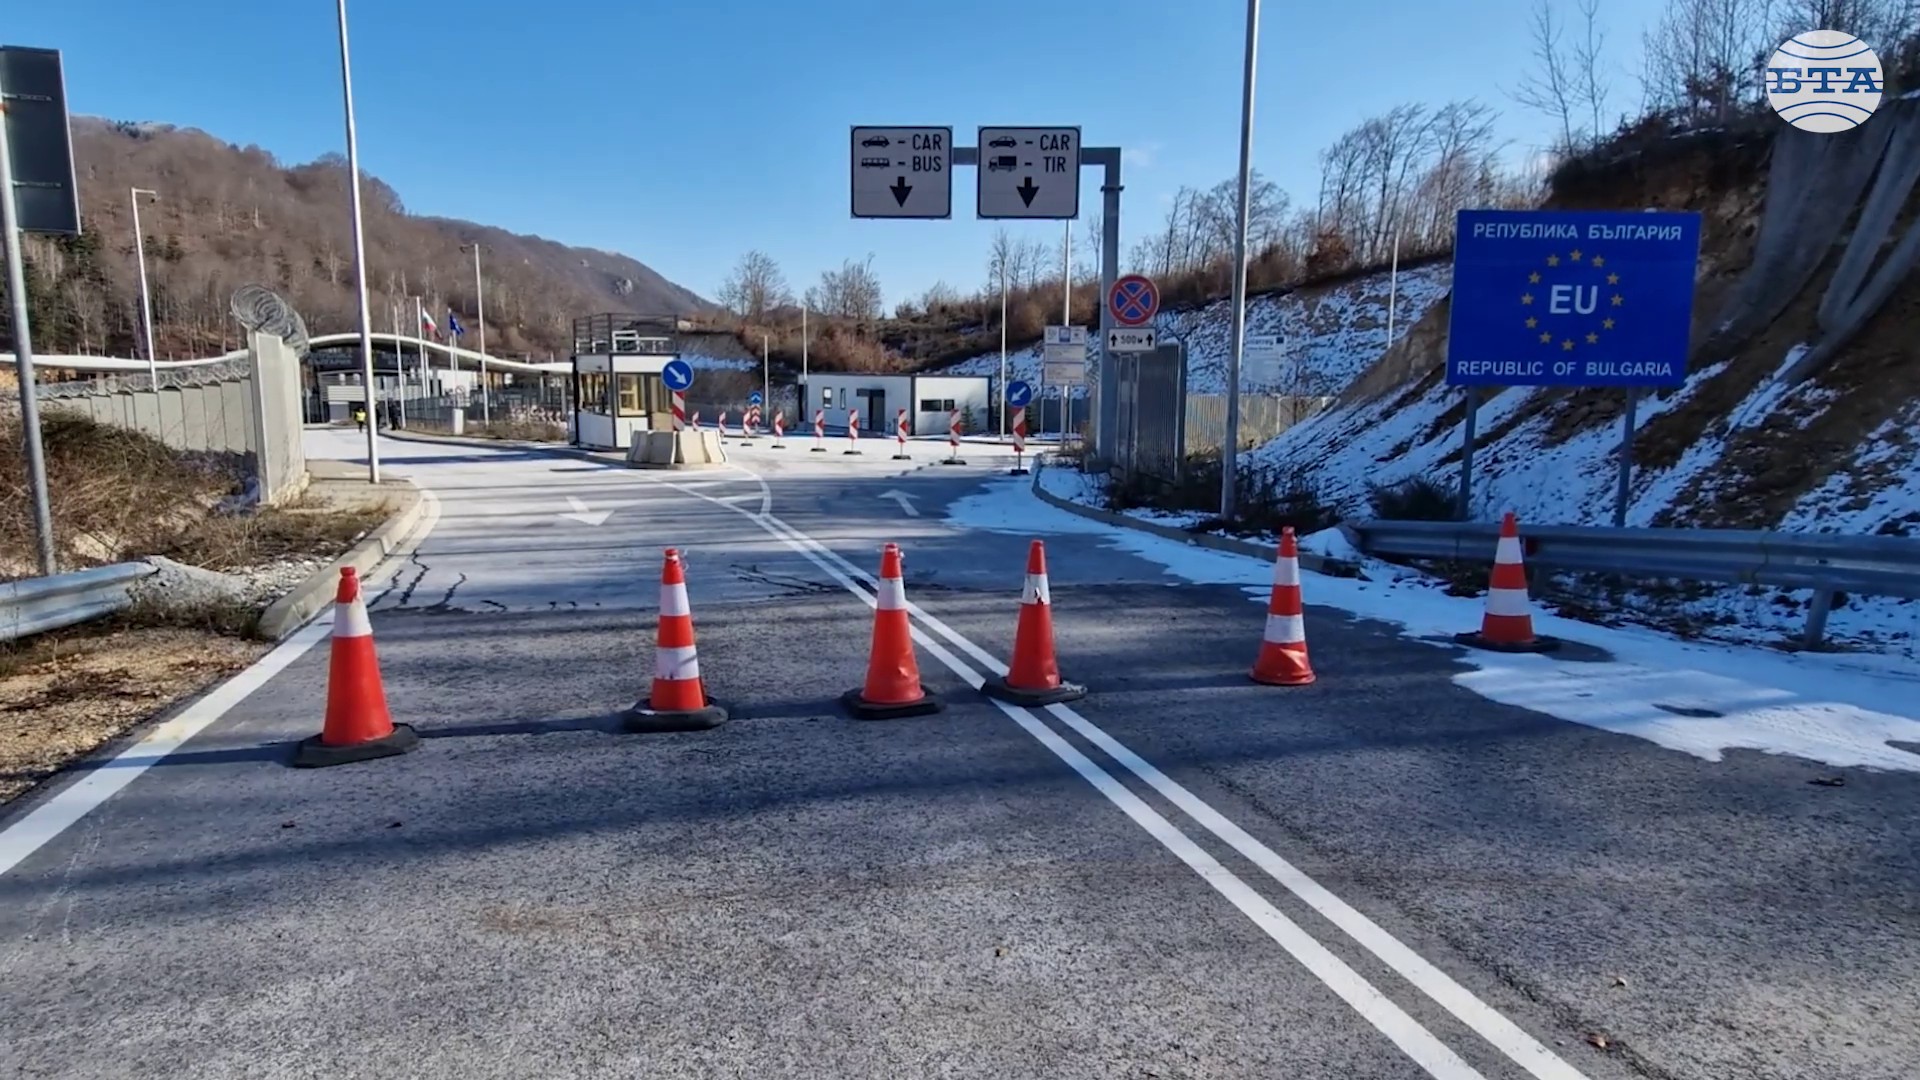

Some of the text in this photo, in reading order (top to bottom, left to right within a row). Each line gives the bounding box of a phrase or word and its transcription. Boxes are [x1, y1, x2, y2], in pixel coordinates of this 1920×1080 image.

[912, 133, 942, 151] CAR
[1039, 134, 1070, 151] CAR
[912, 156, 942, 172] BUS
[1043, 156, 1066, 173] TIR
[1473, 223, 1682, 240] РЕПУБЛИКА БЪЛГАРИЯ
[1549, 284, 1599, 315] EU
[1456, 361, 1673, 377] REPUBLIC OF BULGARIA
